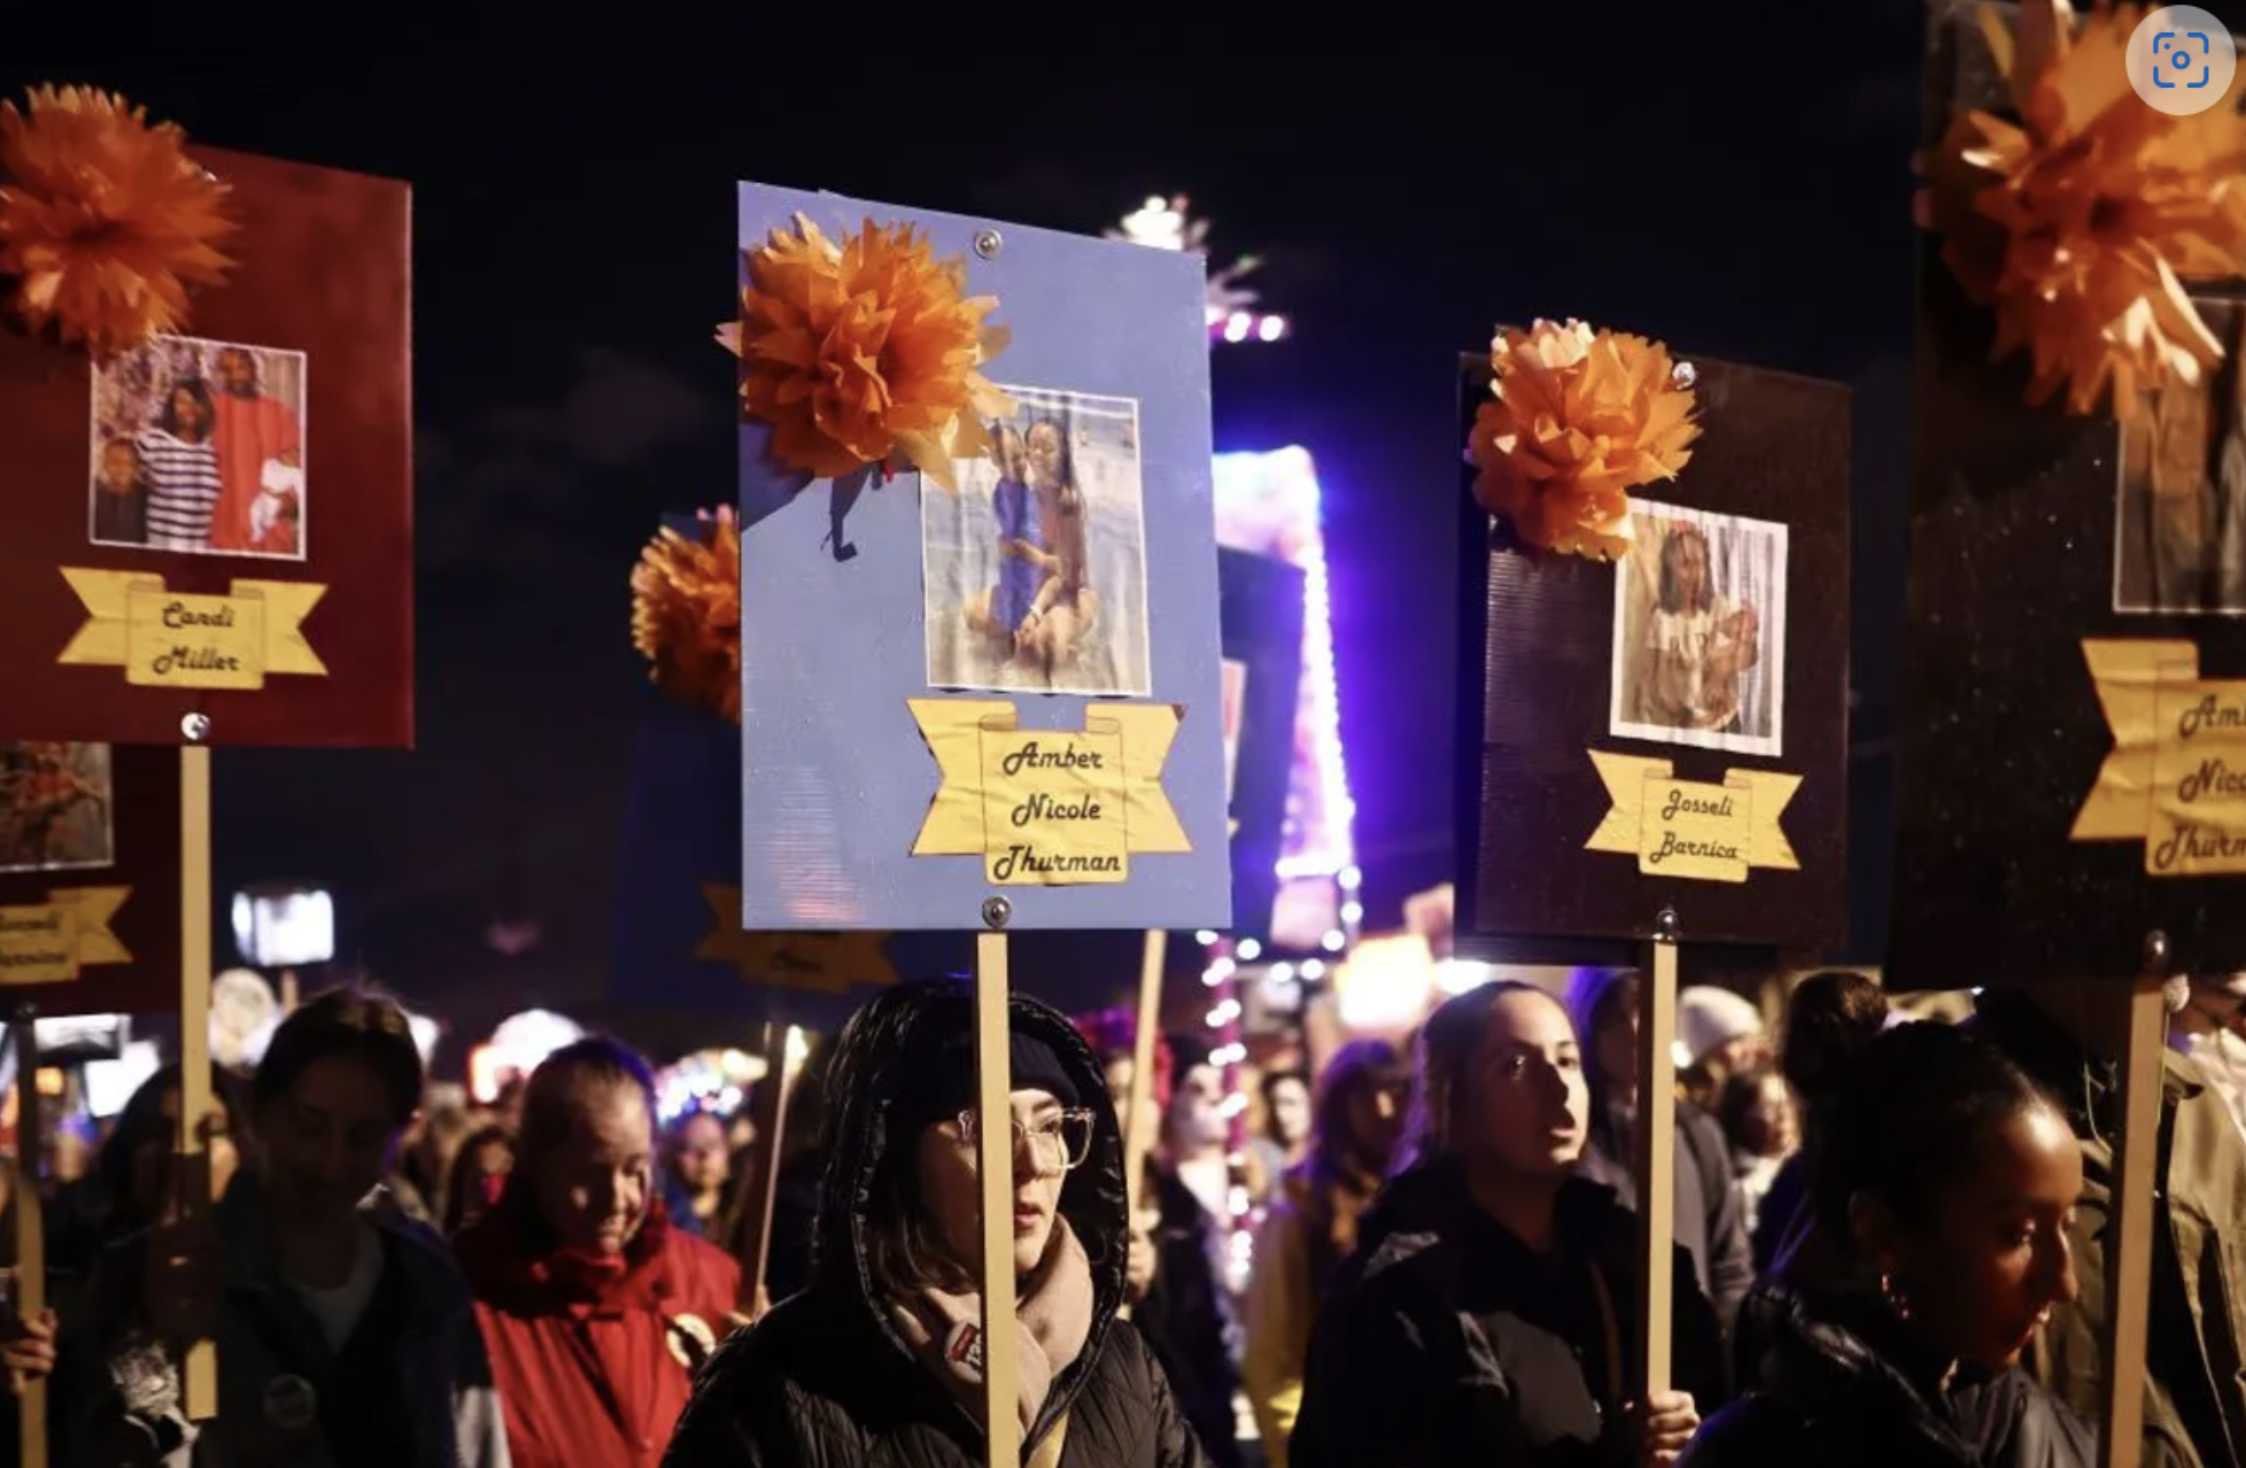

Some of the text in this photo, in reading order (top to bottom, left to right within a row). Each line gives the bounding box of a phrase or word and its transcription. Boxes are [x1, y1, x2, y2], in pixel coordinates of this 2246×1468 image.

[162, 601, 235, 629] Candi
[152, 646, 240, 675] Miller
[1003, 742, 1103, 776] Amber
[1011, 794, 1101, 827] Nicole
[1661, 788, 1733, 820] Josseli
[993, 845, 1121, 880] Thurman
[1650, 831, 1738, 864] Barnica
